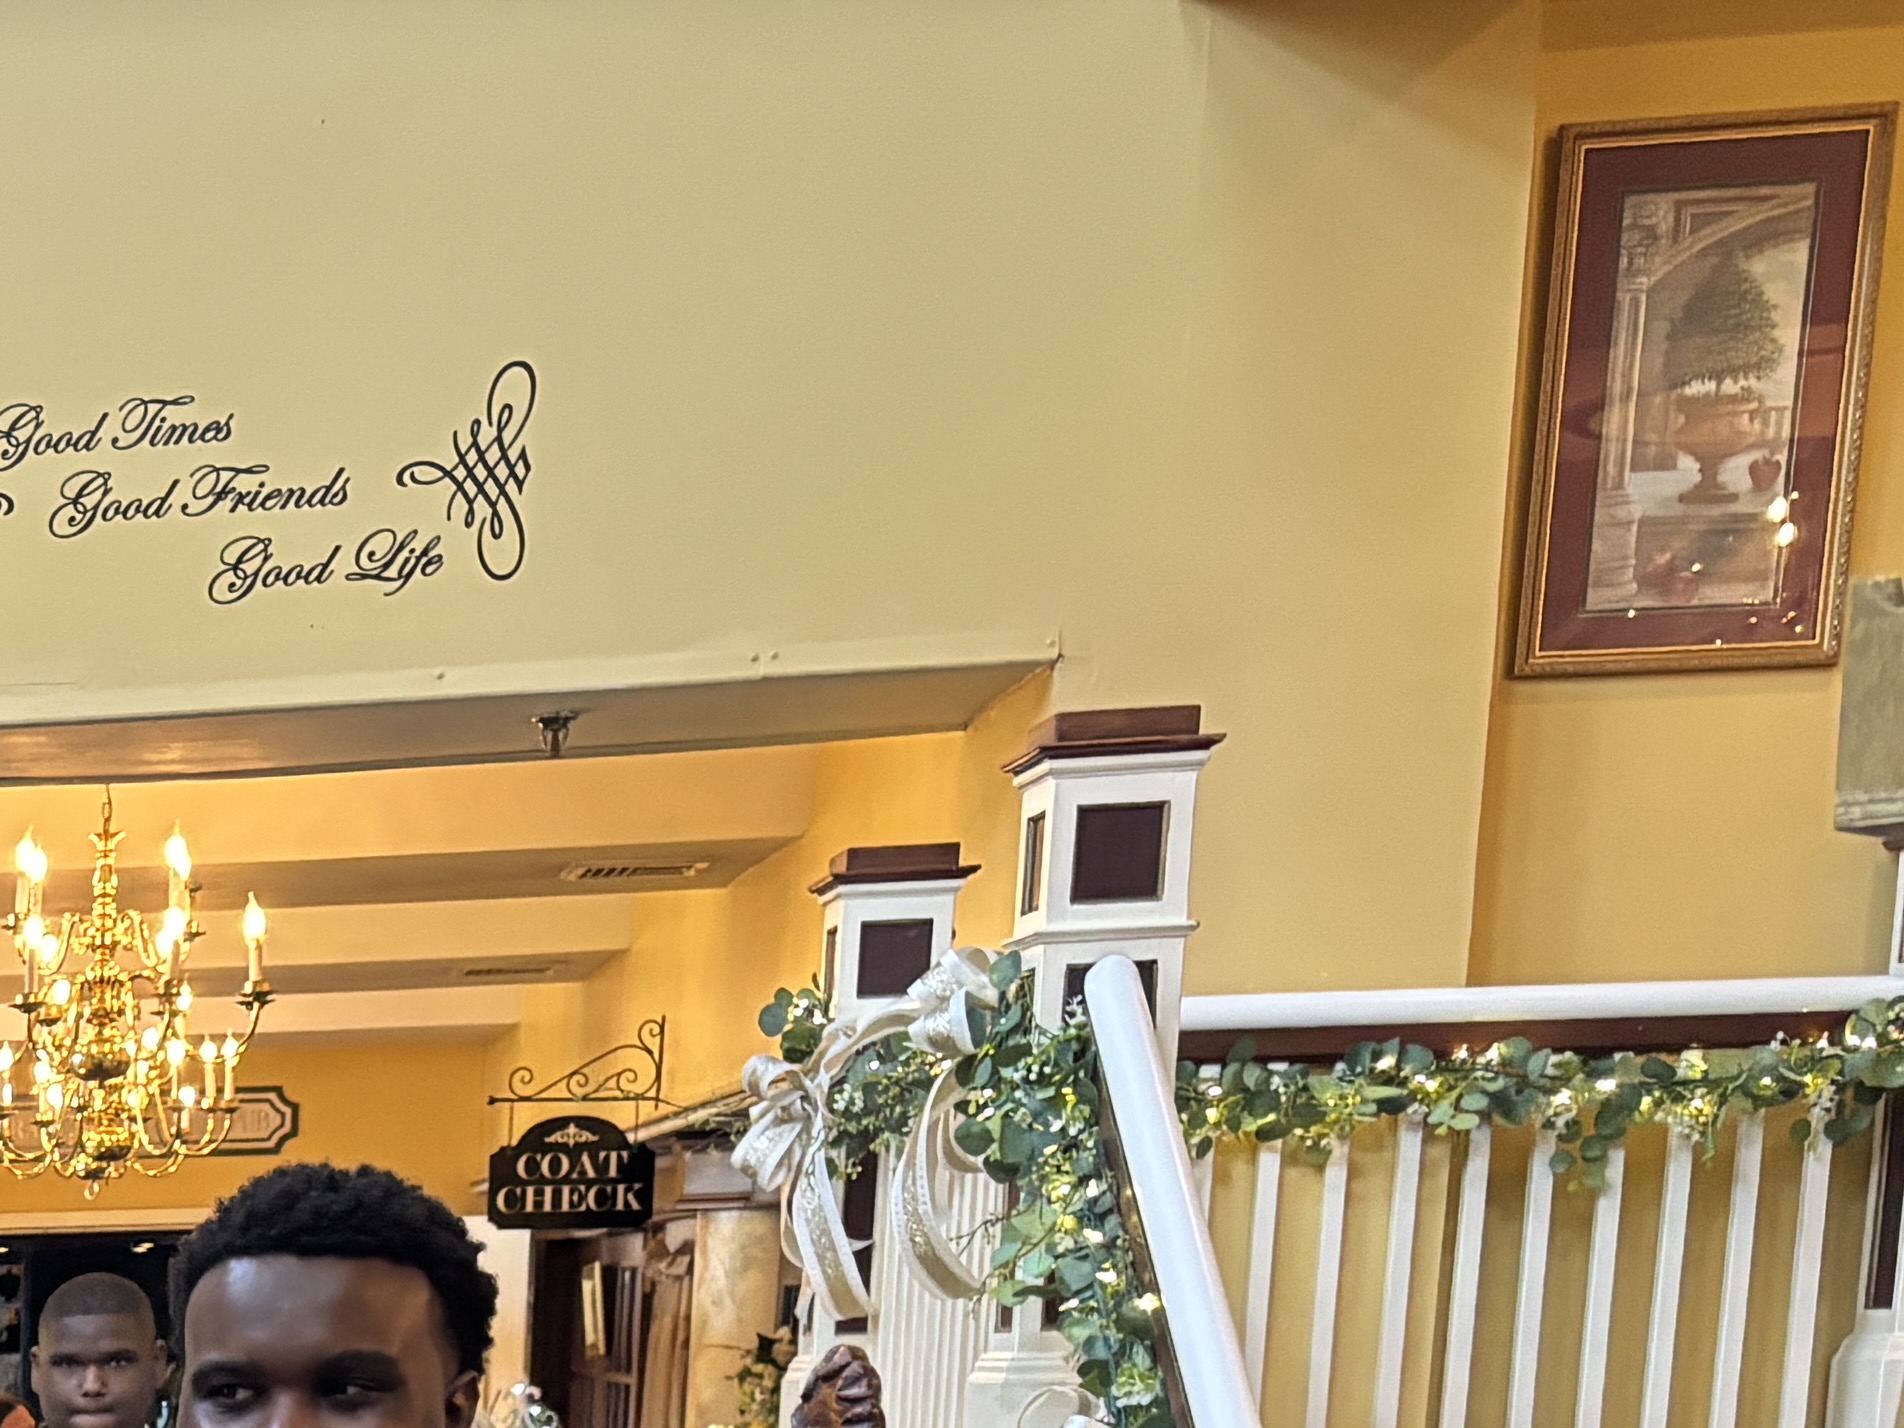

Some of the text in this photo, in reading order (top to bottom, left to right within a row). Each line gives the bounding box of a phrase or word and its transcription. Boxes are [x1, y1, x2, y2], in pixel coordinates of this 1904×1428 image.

[111, 395, 234, 451] Times
[49, 464, 349, 539] Good Friends
[208, 528, 445, 605] Good Life
[517, 1151, 629, 1180] COAT
[496, 1183, 643, 1214] CHECK
